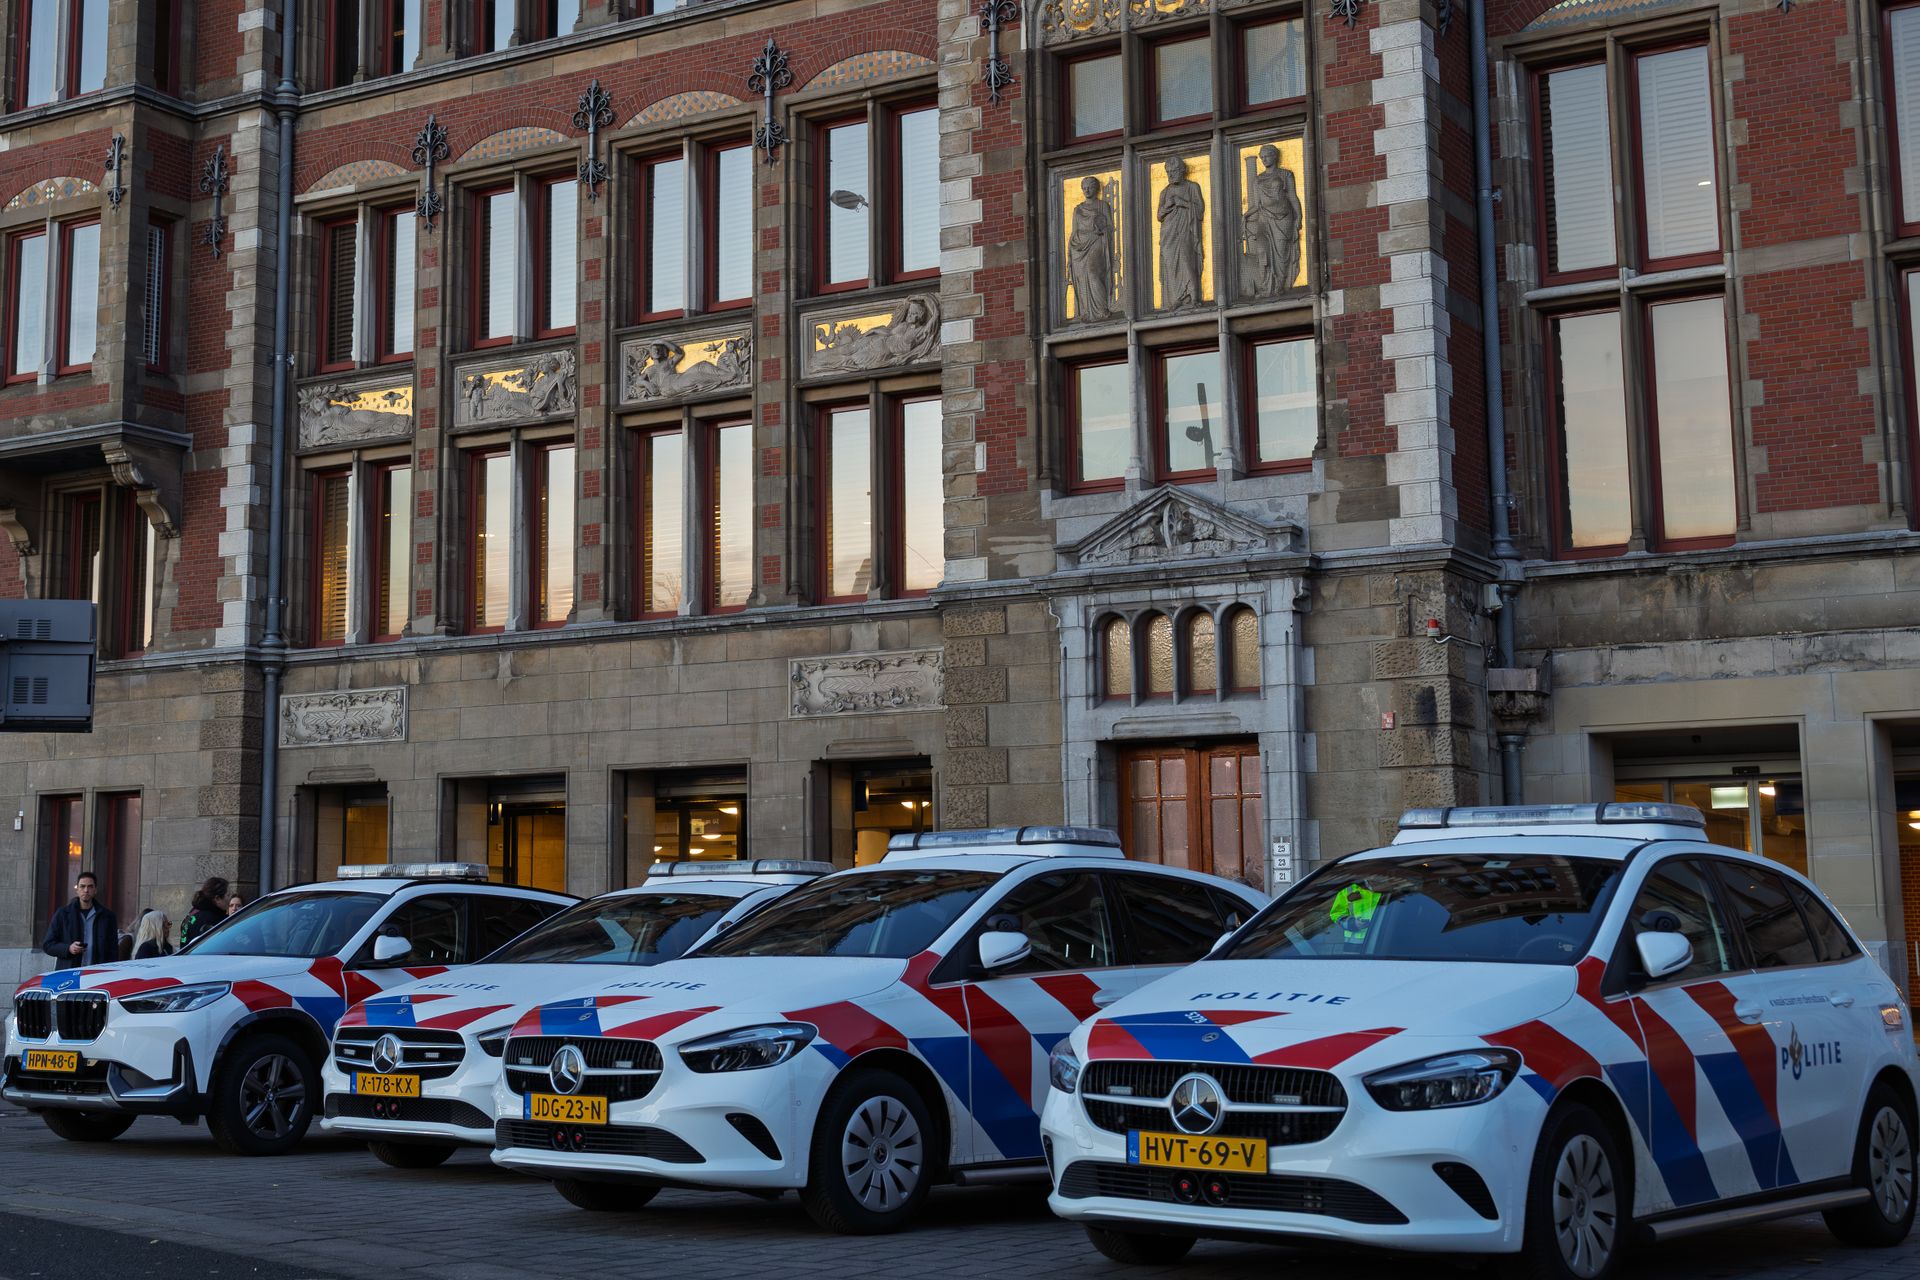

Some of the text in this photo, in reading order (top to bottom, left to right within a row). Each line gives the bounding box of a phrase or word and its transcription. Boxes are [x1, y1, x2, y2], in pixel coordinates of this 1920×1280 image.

[1278, 858, 1287, 867] 23
[1279, 872, 1286, 881] 21
[602, 981, 707, 991] POLITIE
[1190, 992, 1351, 1005] POLITIE
[28, 1052, 75, 1069] HPN-48-G
[361, 1075, 413, 1095] X-178-KX
[534, 1097, 601, 1120] JDG-23-N
[1129, 1149, 1139, 1159] NL
[1145, 1136, 1257, 1168] HVT-69-V
